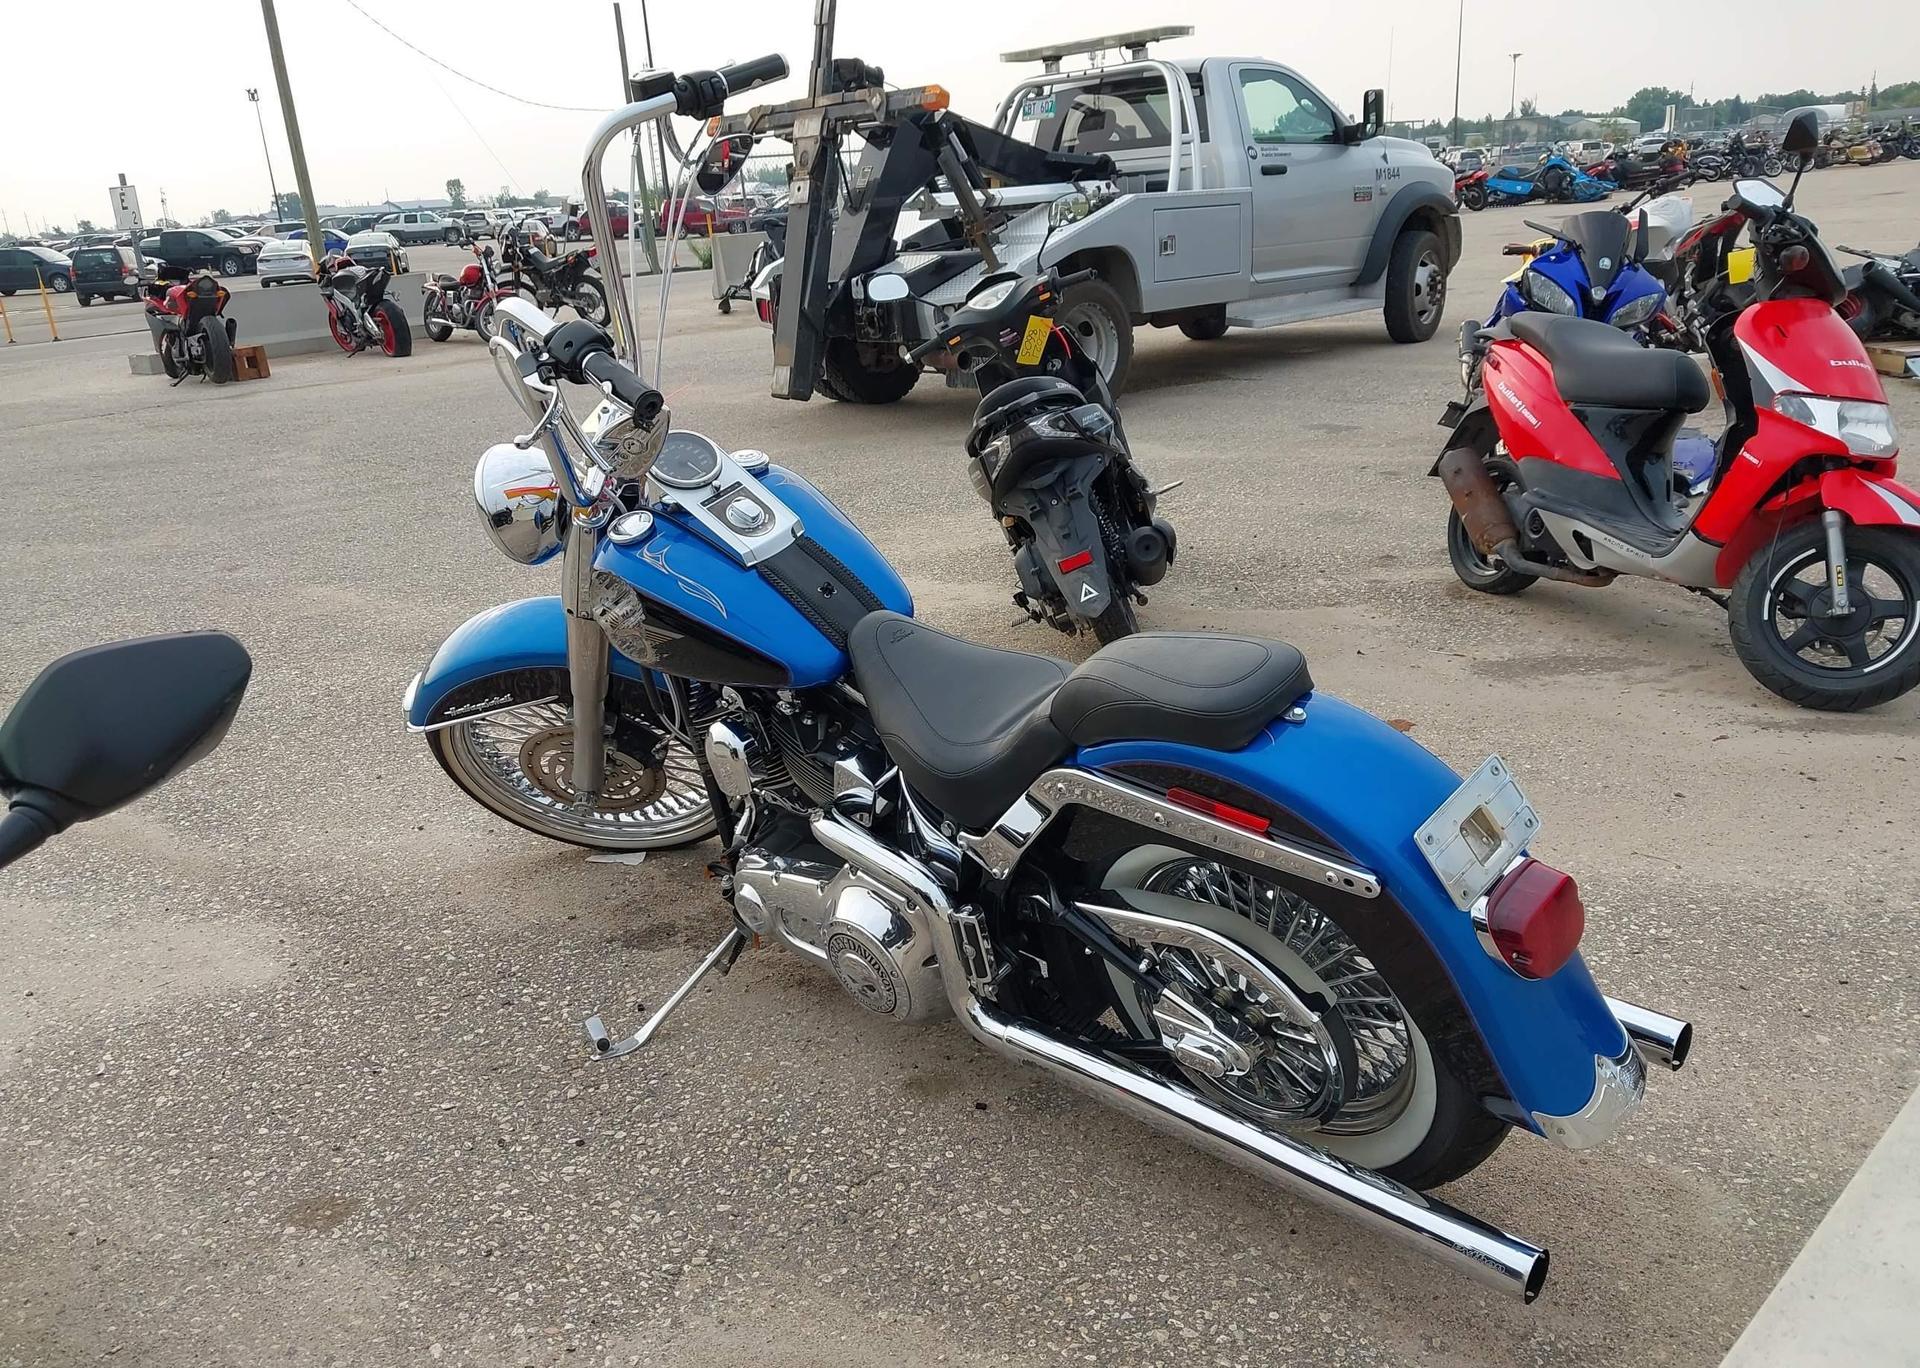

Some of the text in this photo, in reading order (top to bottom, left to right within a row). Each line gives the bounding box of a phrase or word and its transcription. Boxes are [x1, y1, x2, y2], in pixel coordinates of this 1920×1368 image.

[1375, 166, 1401, 180] M1844
[119, 192, 128, 210] E
[1021, 329, 1037, 357] 8605
[1498, 381, 1523, 408] bullet
